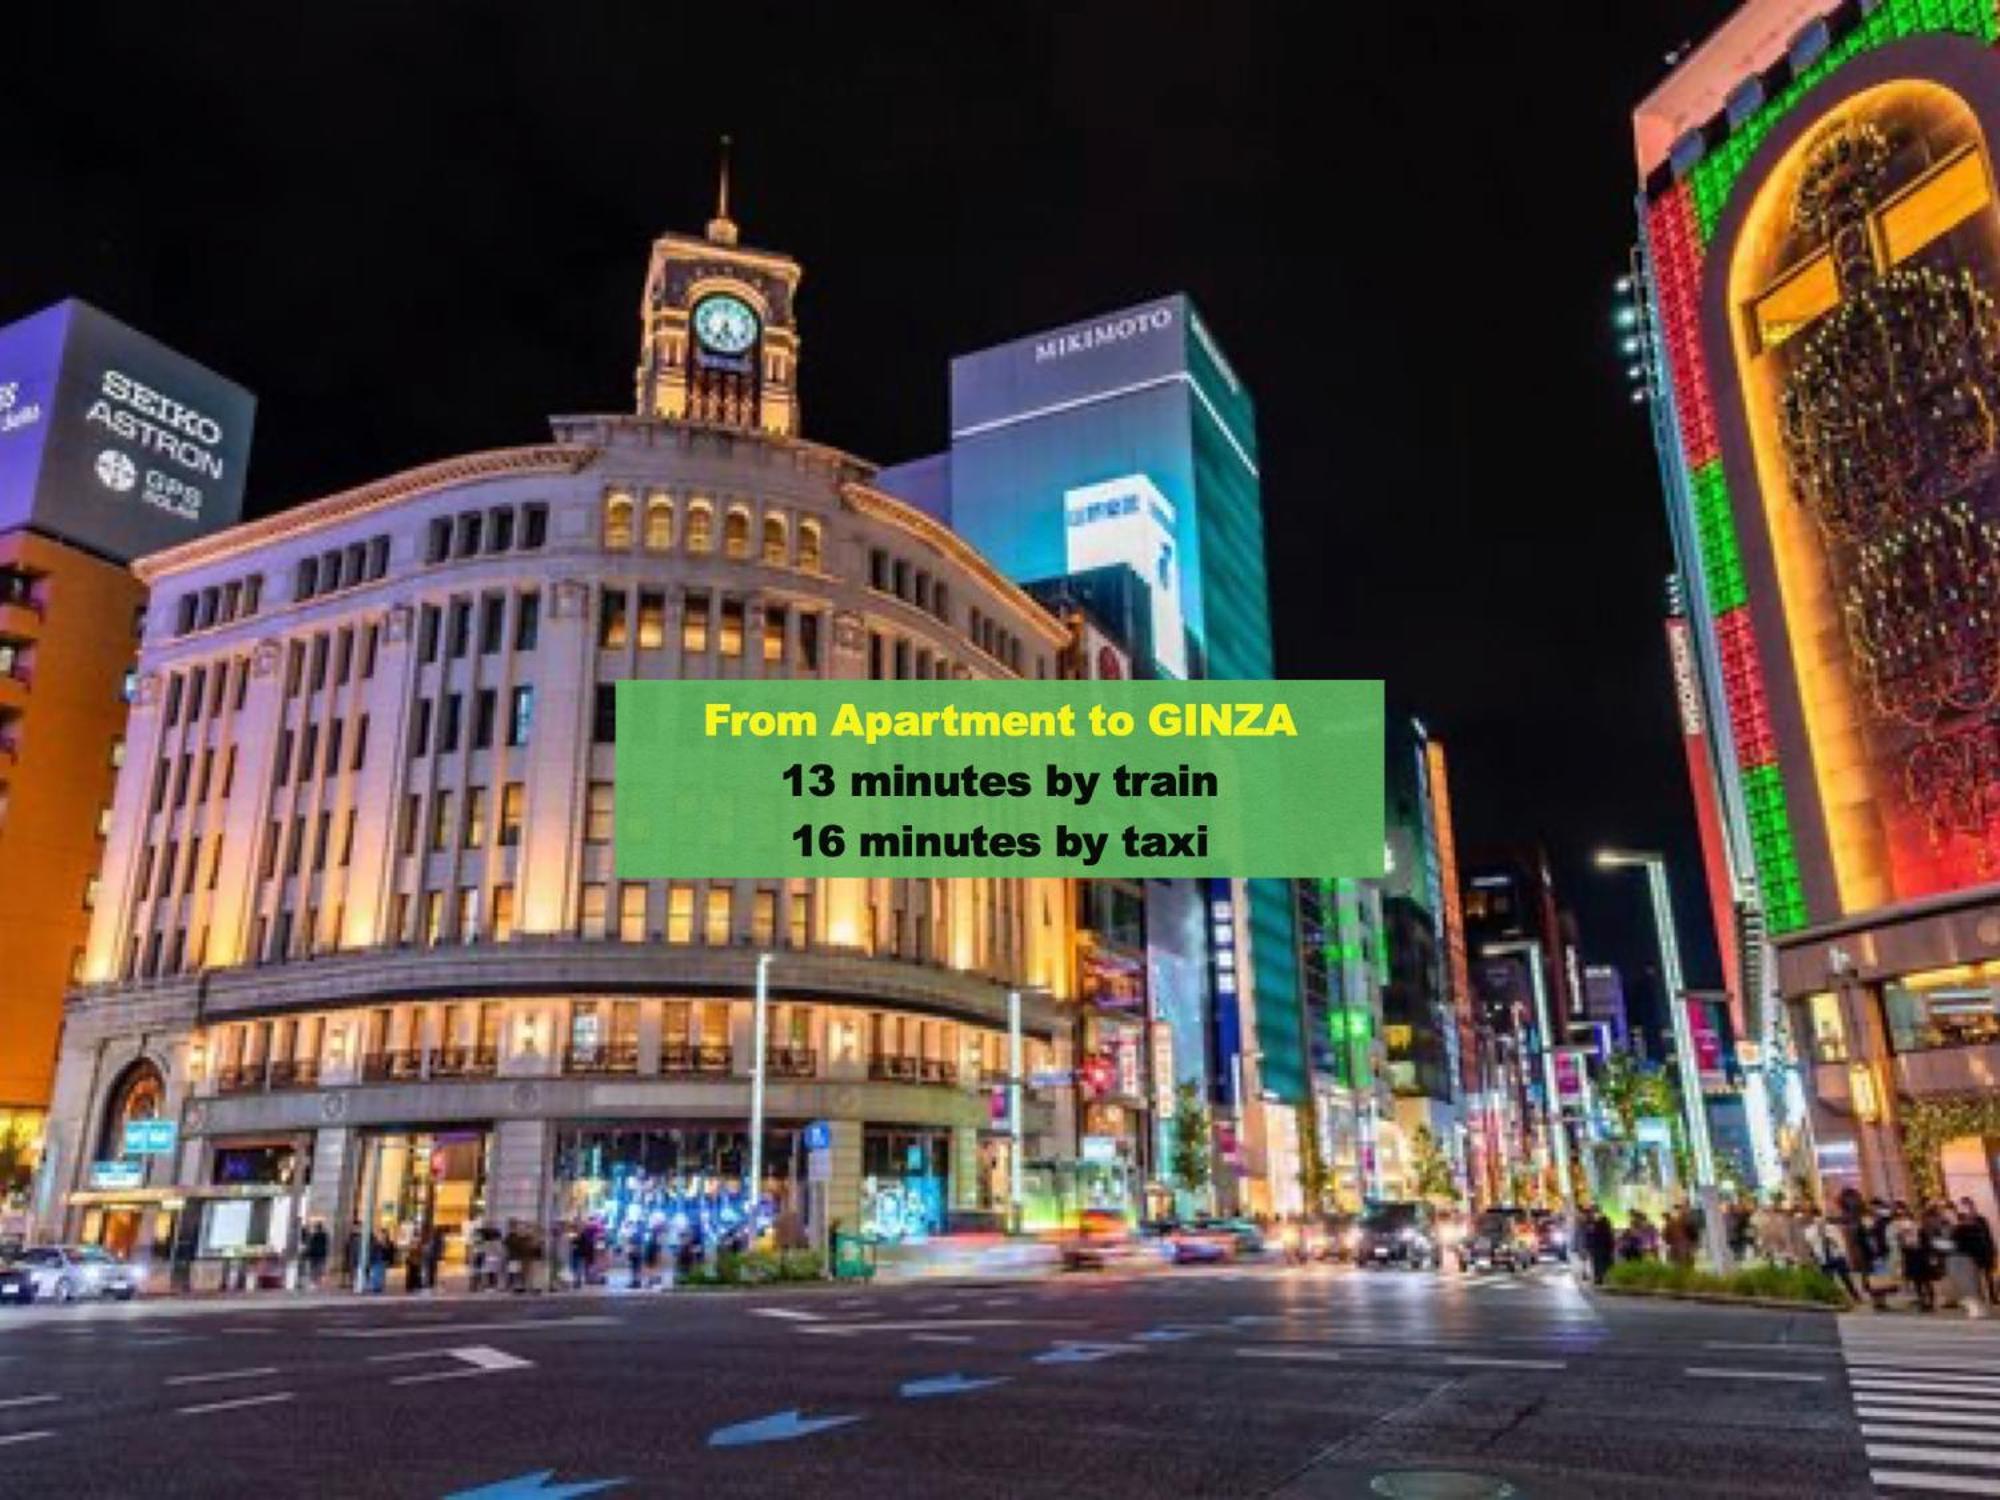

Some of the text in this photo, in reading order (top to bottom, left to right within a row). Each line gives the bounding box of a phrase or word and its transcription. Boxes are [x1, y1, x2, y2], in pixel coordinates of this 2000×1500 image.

[1036, 306, 1172, 363] MIKIMOTO
[86, 400, 223, 479] ASTRON
[102, 370, 222, 444] SEIKO
